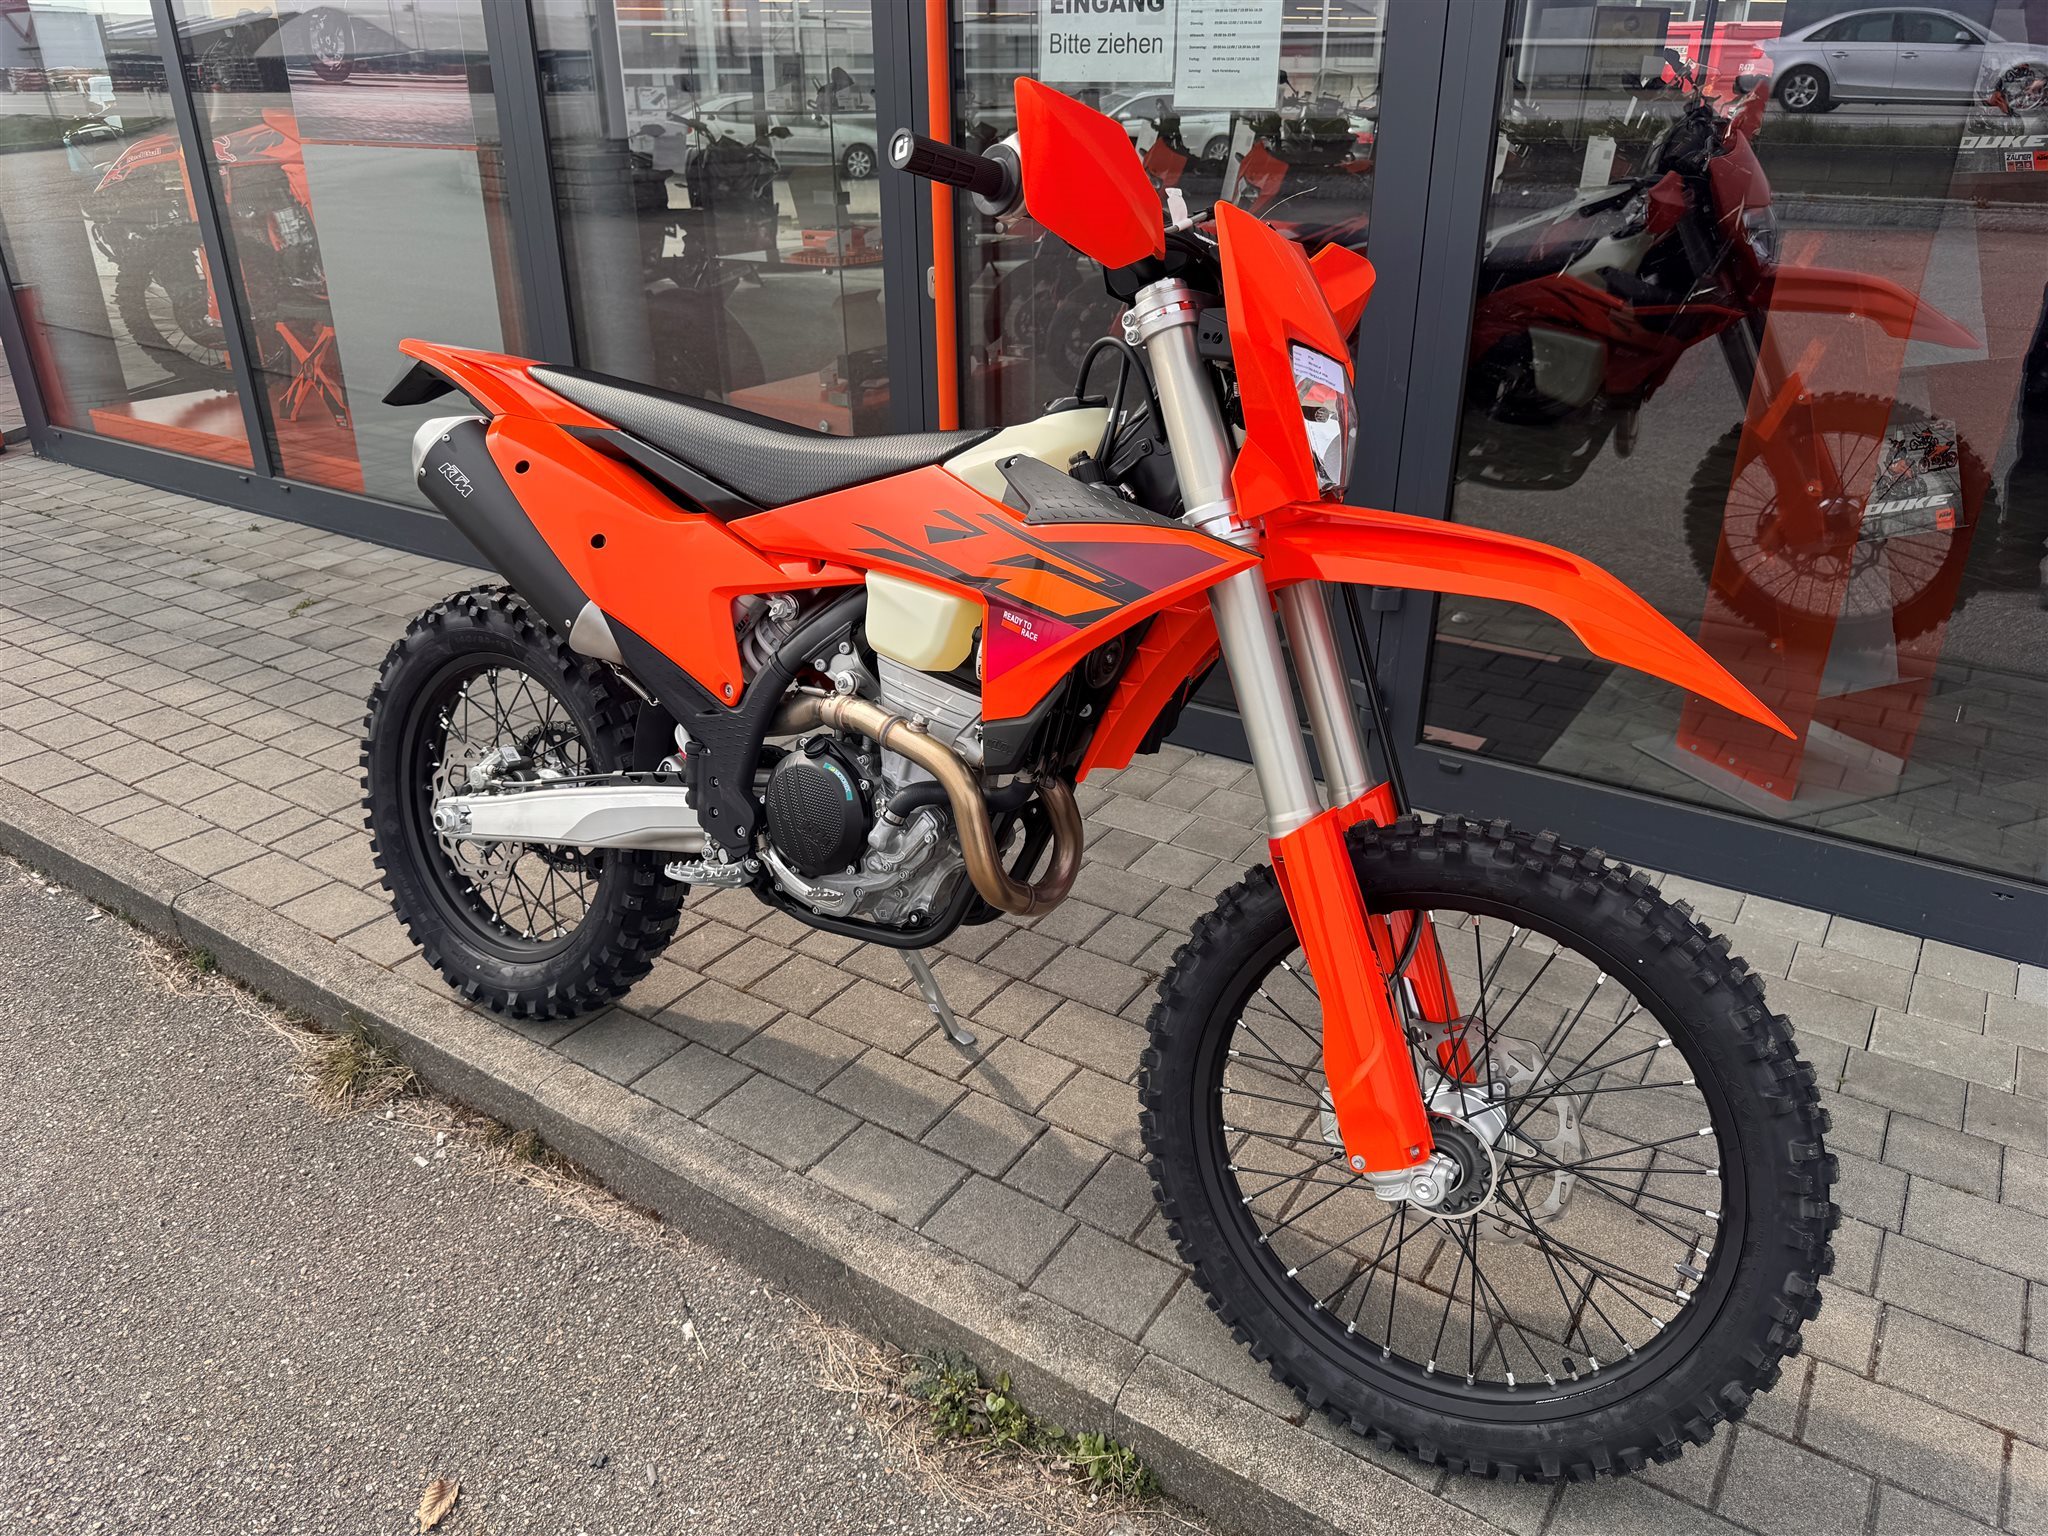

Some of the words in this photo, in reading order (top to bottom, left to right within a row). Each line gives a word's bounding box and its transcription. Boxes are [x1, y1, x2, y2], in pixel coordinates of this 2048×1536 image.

[1051, 0, 1164, 14] EINGANG
[1050, 33, 1091, 54] Bitte
[1097, 32, 1163, 54] ziehen
[1959, 136, 2048, 148] DUKE
[2006, 153, 2031, 161] ZAUNER
[438, 462, 474, 498] KTM
[1864, 493, 1953, 516] DUKE
[1002, 610, 1023, 626] READY
[1023, 619, 1032, 630] TO
[1020, 628, 1039, 642] RACE
